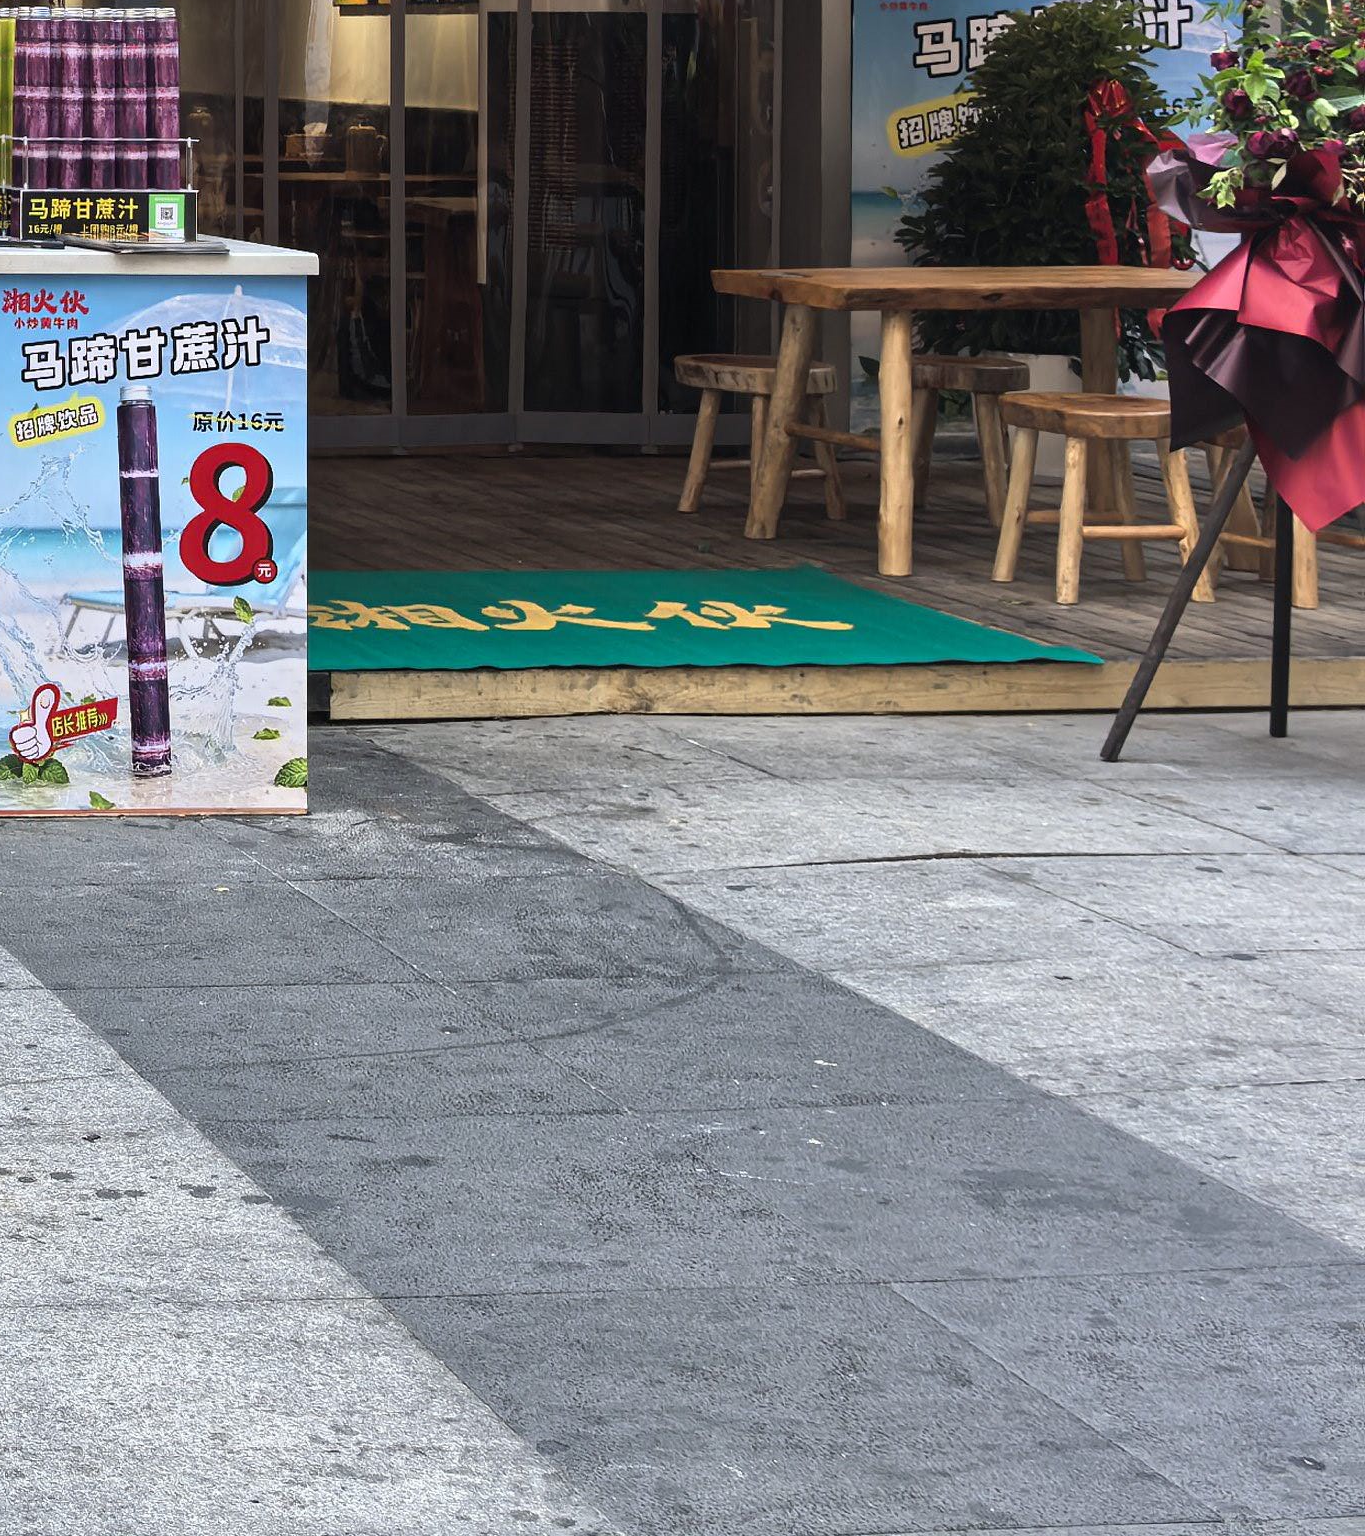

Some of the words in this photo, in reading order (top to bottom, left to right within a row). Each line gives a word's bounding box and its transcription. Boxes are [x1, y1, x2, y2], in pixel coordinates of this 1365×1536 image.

[28, 197, 139, 220] 马蹄甘蔗汁
[1, 288, 90, 316] 湘火伙
[14, 317, 79, 330] 小炒黄牛肉
[22, 316, 270, 390] 马蹄甘蔗汁
[15, 403, 100, 442] 招牌饮品
[192, 411, 285, 433] 原价16元
[179, 442, 274, 586] 8
[257, 562, 272, 578] 元
[309, 600, 855, 632] 湘火伙
[52, 707, 99, 738] 店长推荐
